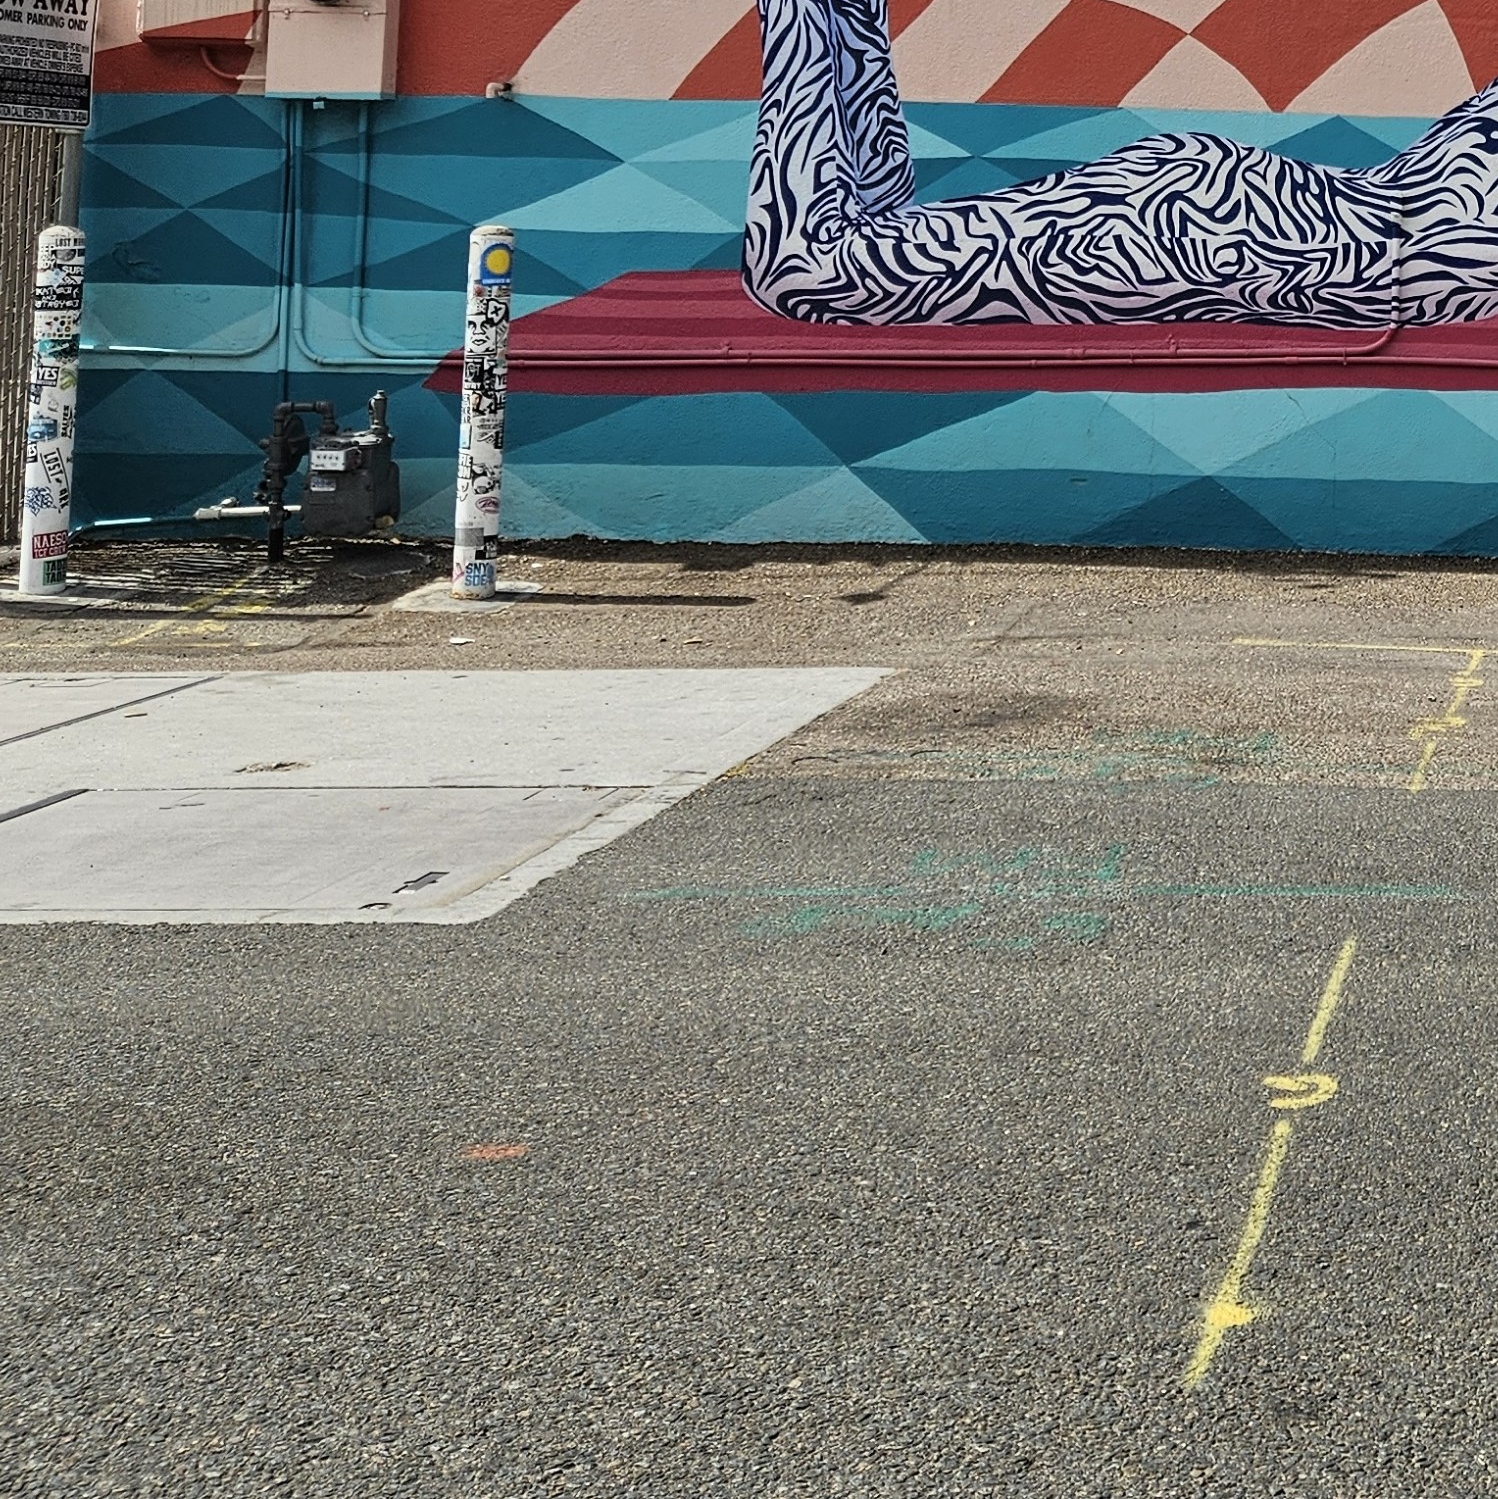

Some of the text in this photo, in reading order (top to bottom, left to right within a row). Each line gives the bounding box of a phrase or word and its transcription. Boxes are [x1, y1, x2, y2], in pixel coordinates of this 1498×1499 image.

[27, 12, 65, 28] PARKING
[68, 18, 88, 32] ONLY
[38, 368, 58, 380] YES
[44, 451, 64, 477] LOST
